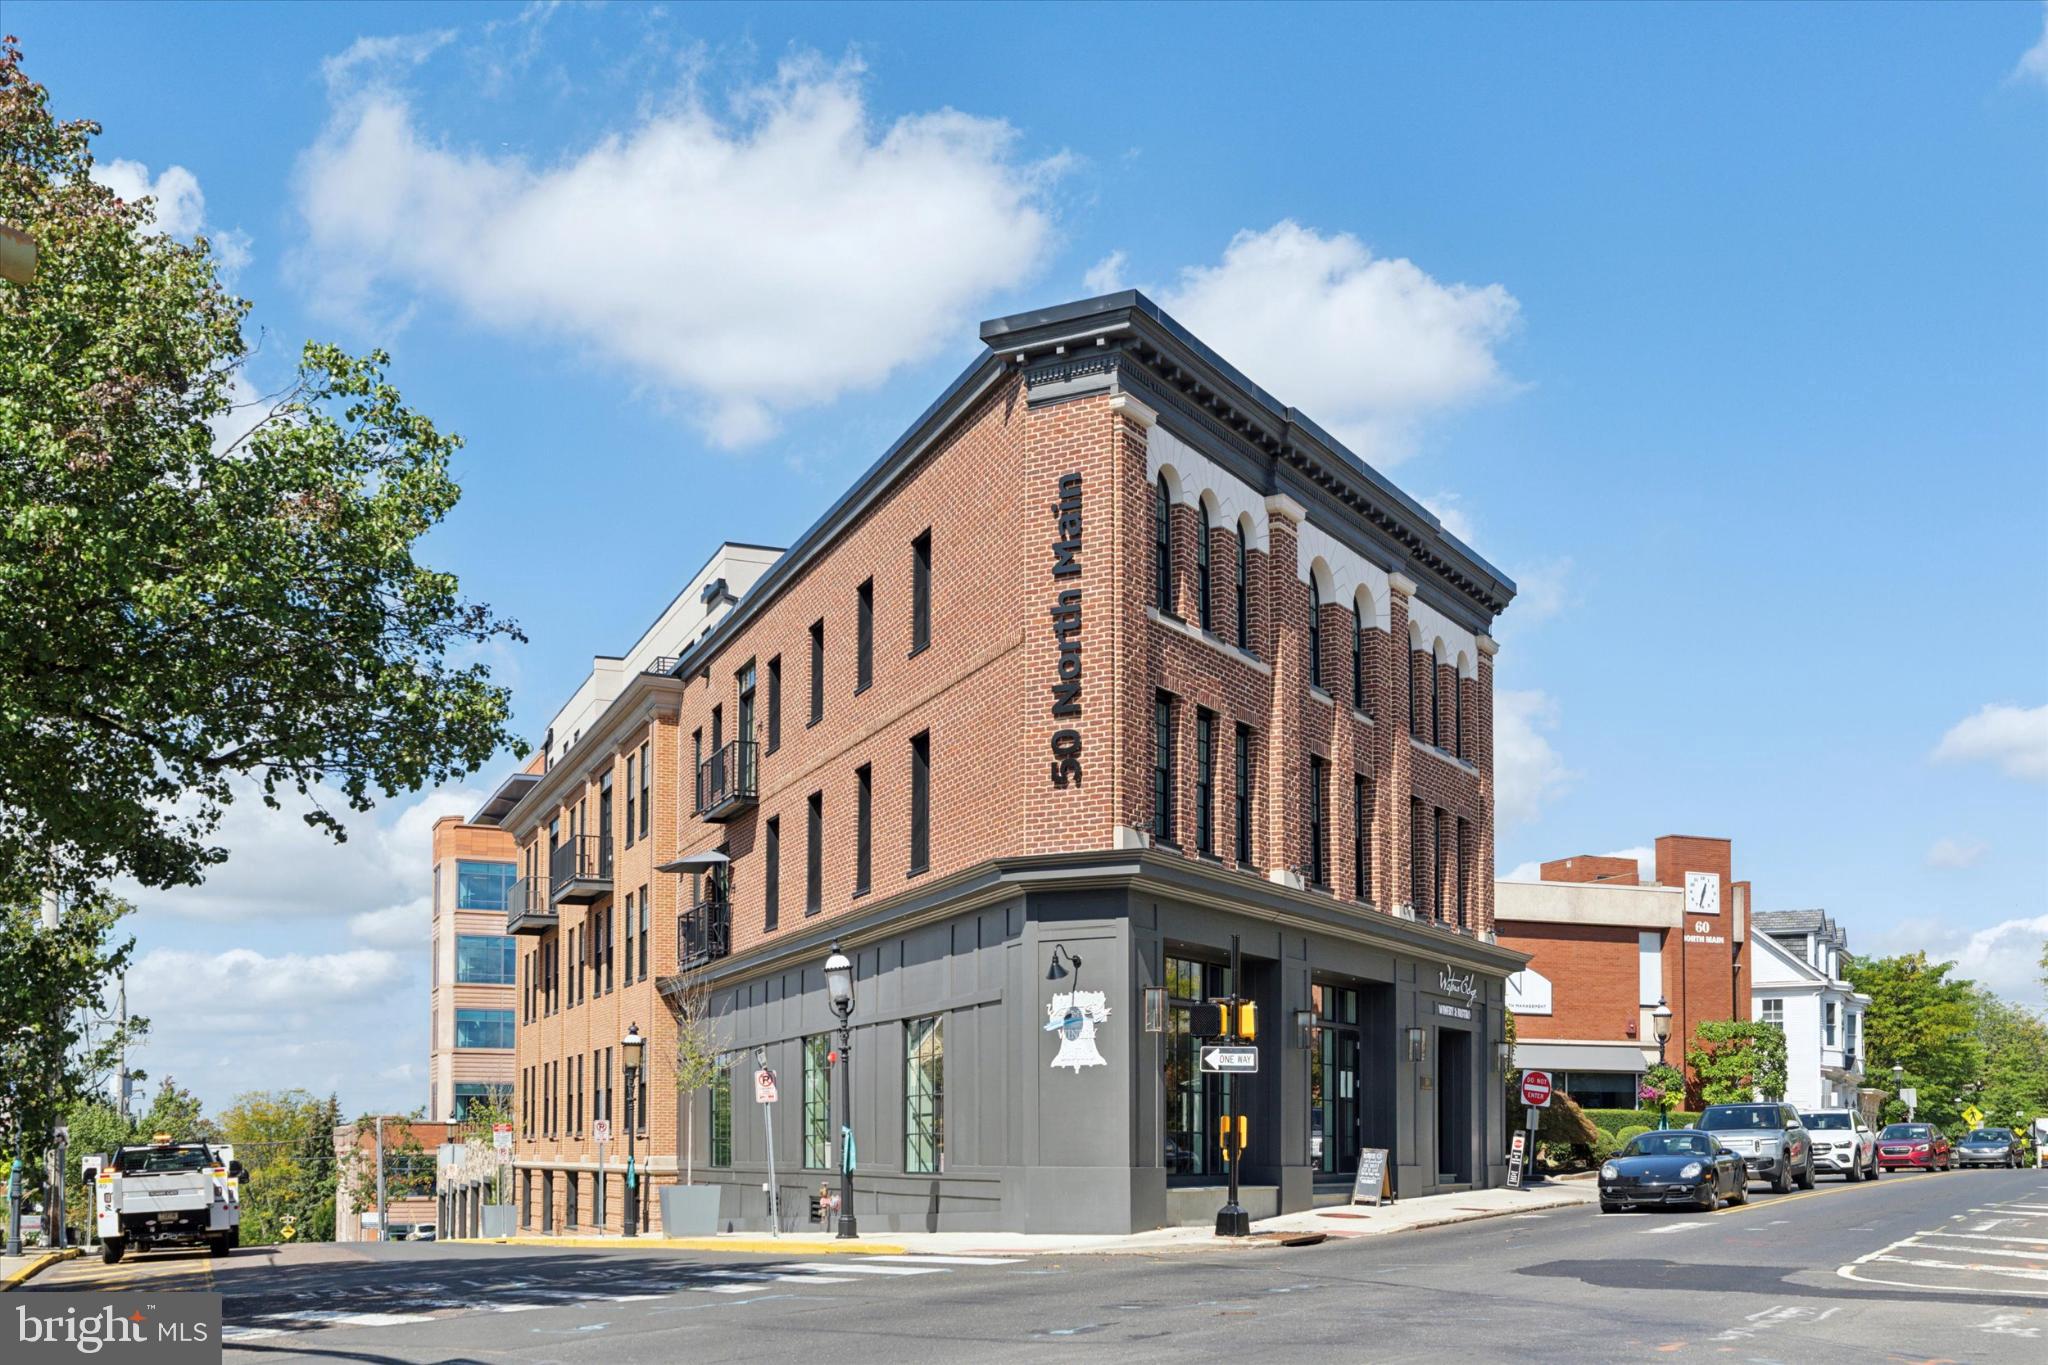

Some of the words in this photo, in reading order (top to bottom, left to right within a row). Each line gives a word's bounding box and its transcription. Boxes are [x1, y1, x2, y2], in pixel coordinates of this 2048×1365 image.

[1051, 471, 1083, 579] Main
[1051, 589, 1083, 718] North
[1051, 728, 1083, 789] 50
[1695, 920, 1710, 934] 60
[1705, 936, 1725, 944] MAIN
[1058, 1027, 1098, 1040] WINY
[1219, 1054, 1234, 1064] ONE
[1237, 1054, 1251, 1064] WAY
[1526, 1076, 1535, 1084] DO
[1536, 1077, 1547, 1085] NOT
[1527, 1091, 1545, 1099] ENTER
